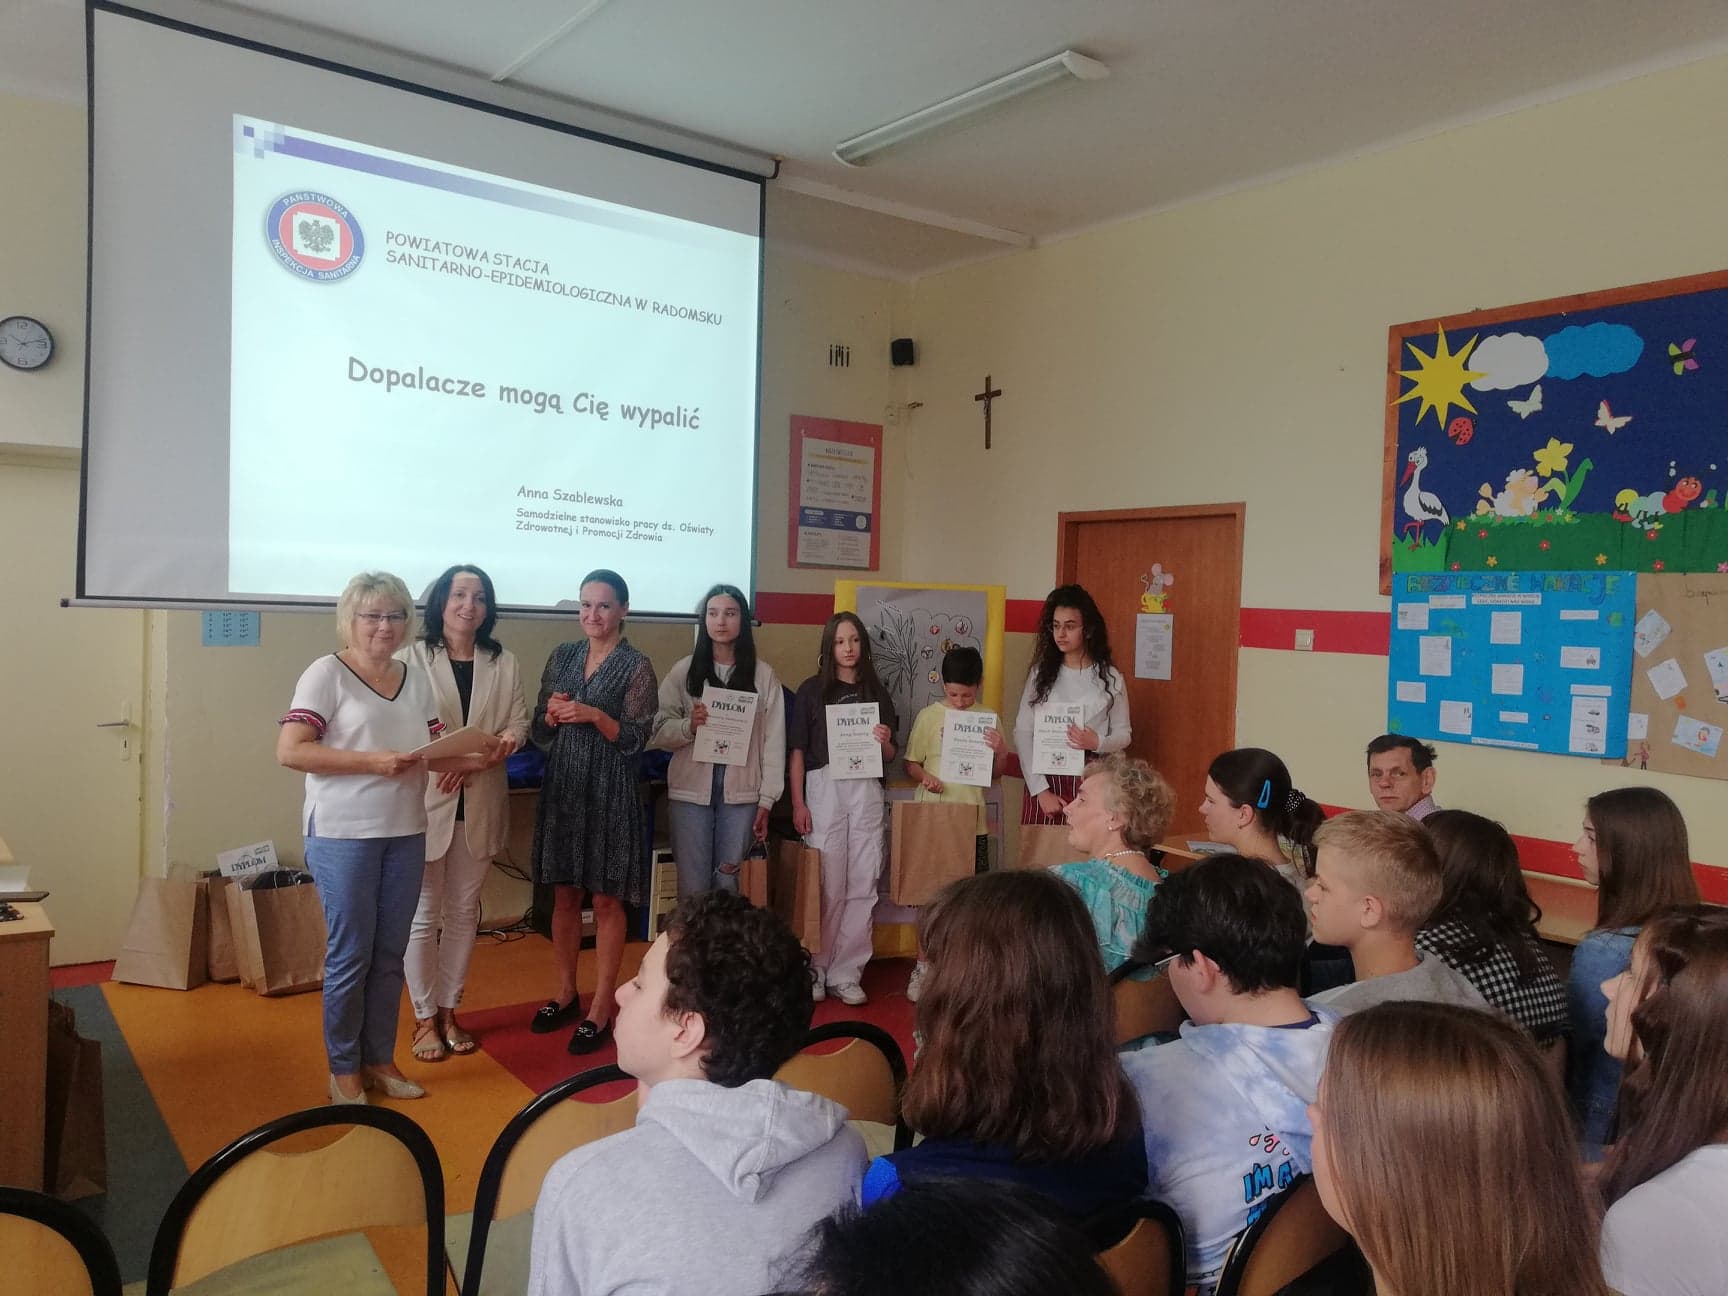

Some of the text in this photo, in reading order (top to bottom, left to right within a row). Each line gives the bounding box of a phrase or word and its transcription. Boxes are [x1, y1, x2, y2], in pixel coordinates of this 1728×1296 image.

[271, 239, 361, 280] INSPEKCJA SANITARNA
[385, 230, 550, 275] POWIATOWA STACJA
[385, 250, 722, 326] SANITARNO-EPIDEMIOLOGICZNA W RADOMSKU
[347, 356, 701, 430] Dopalacze mogą Cię wypalić
[517, 485, 624, 507] Anna Szablewska
[515, 520, 573, 536] Zdrowotnej
[582, 526, 624, 540] Promocji
[625, 529, 663, 542] Zdrowia
[516, 507, 715, 536] Samodzielne stanowisko pracy ds. Oświaty
[1406, 574, 1520, 592] BEZPIECZNE
[1530, 574, 1623, 606] WAKACJE
[711, 700, 746, 713] DYPLOM
[836, 717, 870, 726] DYPLOM
[231, 856, 267, 872] DYPLOM
